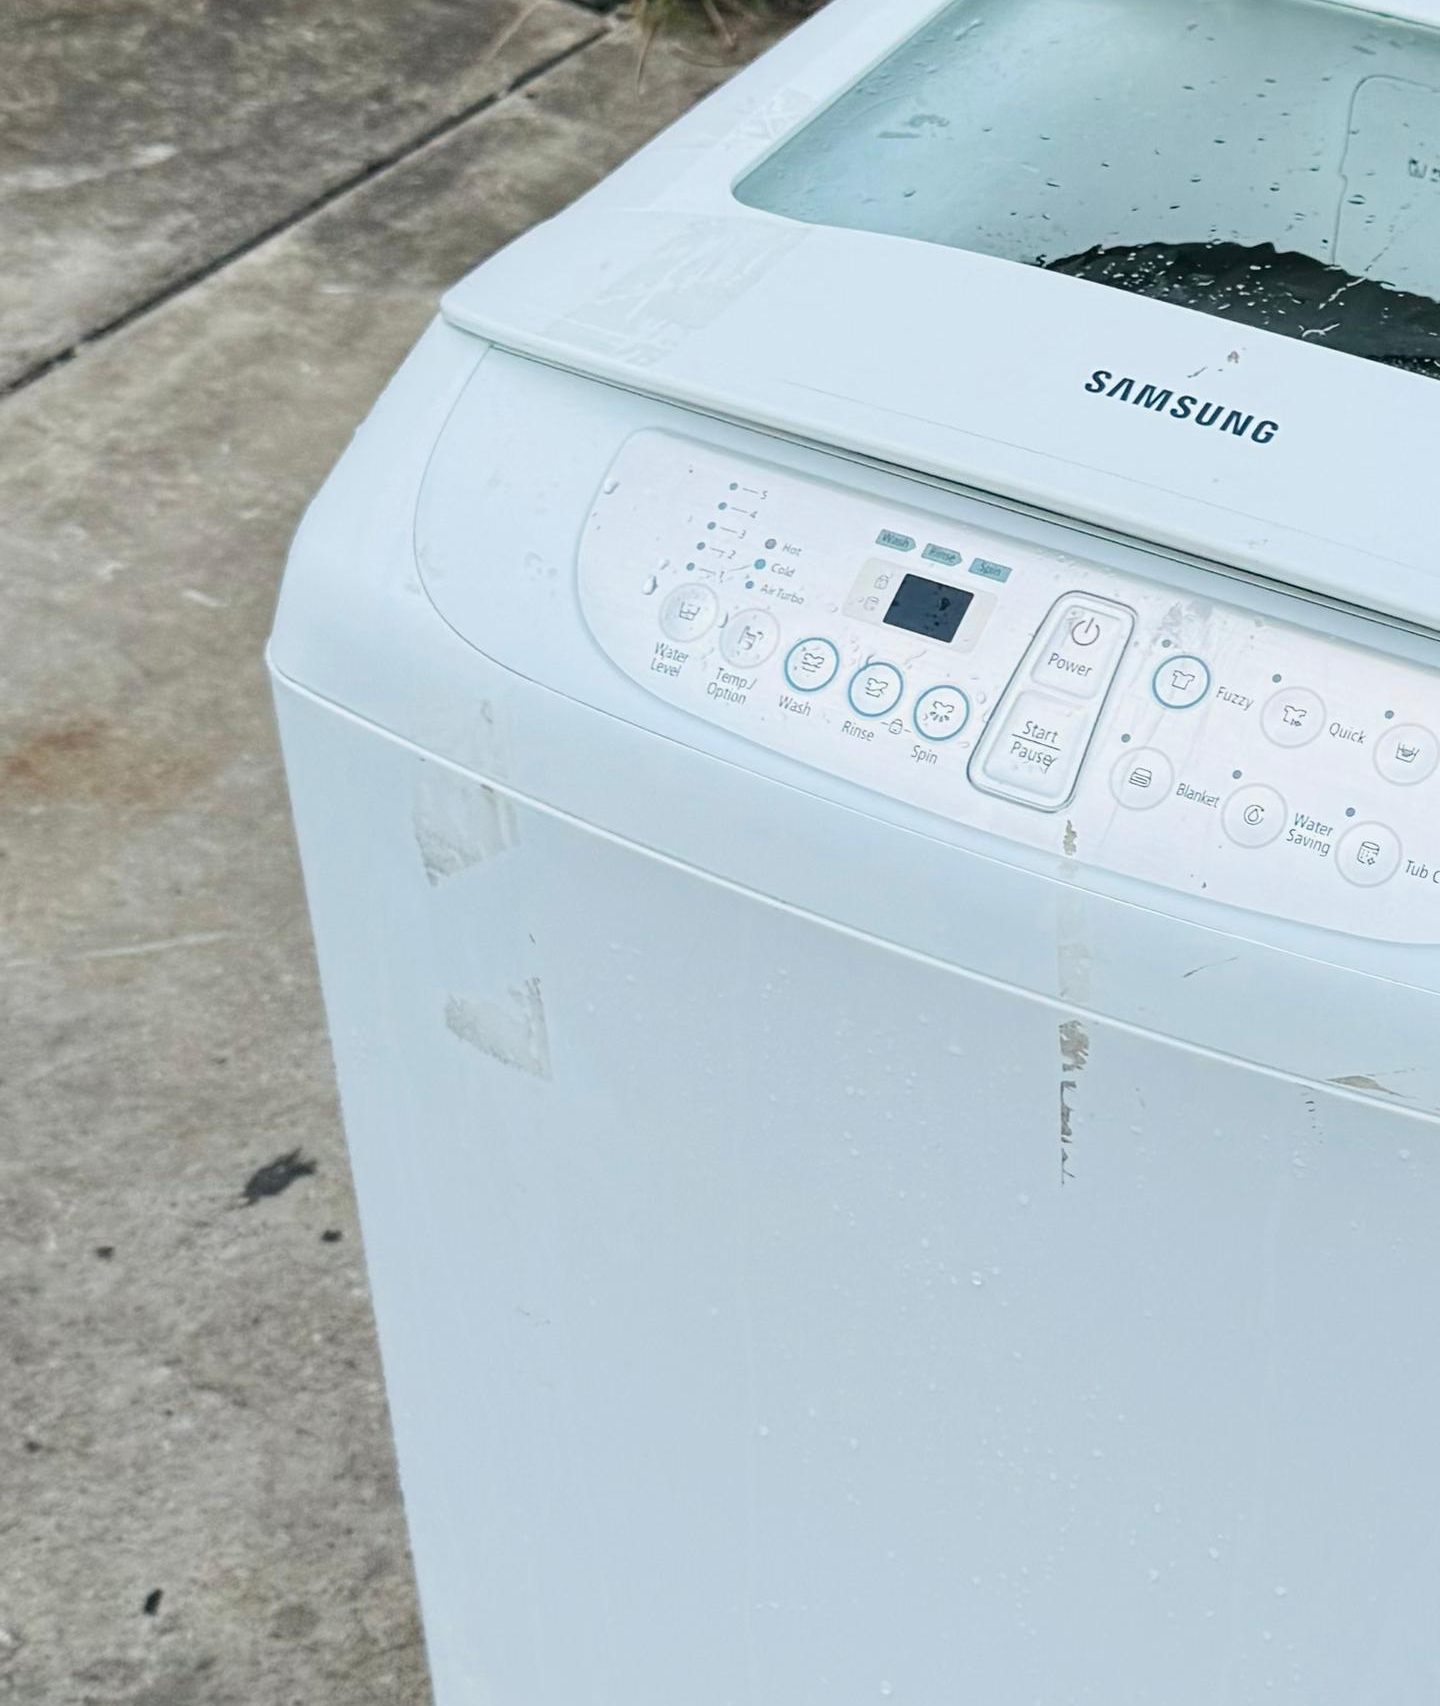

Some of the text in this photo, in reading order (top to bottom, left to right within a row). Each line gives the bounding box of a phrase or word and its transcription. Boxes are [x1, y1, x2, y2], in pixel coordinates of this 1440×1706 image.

[1085, 370, 1279, 444] SAMSUNG
[760, 490, 768, 500] 5
[749, 510, 758, 519] 4
[738, 530, 747, 540] 3
[882, 533, 910, 547] Wash
[727, 550, 736, 559] 2
[782, 543, 802, 557] Hot
[771, 563, 796, 577] Cold
[980, 563, 1003, 576] Spin
[653, 642, 690, 663] Water
[650, 657, 682, 678] Level
[1048, 652, 1093, 677] Power
[707, 681, 747, 705] Option
[1215, 686, 1254, 711] Fuzzy
[779, 694, 812, 717] Wash
[841, 720, 875, 742] Rinse
[1022, 720, 1059, 743] Start
[1329, 722, 1367, 744] Quick
[911, 745, 938, 765] Spin
[1010, 740, 1055, 766] Pause
[1176, 782, 1220, 808] Blanket
[1293, 812, 1334, 837] Water
[1286, 828, 1331, 857] Saving
[1405, 859, 1429, 880] Tub
